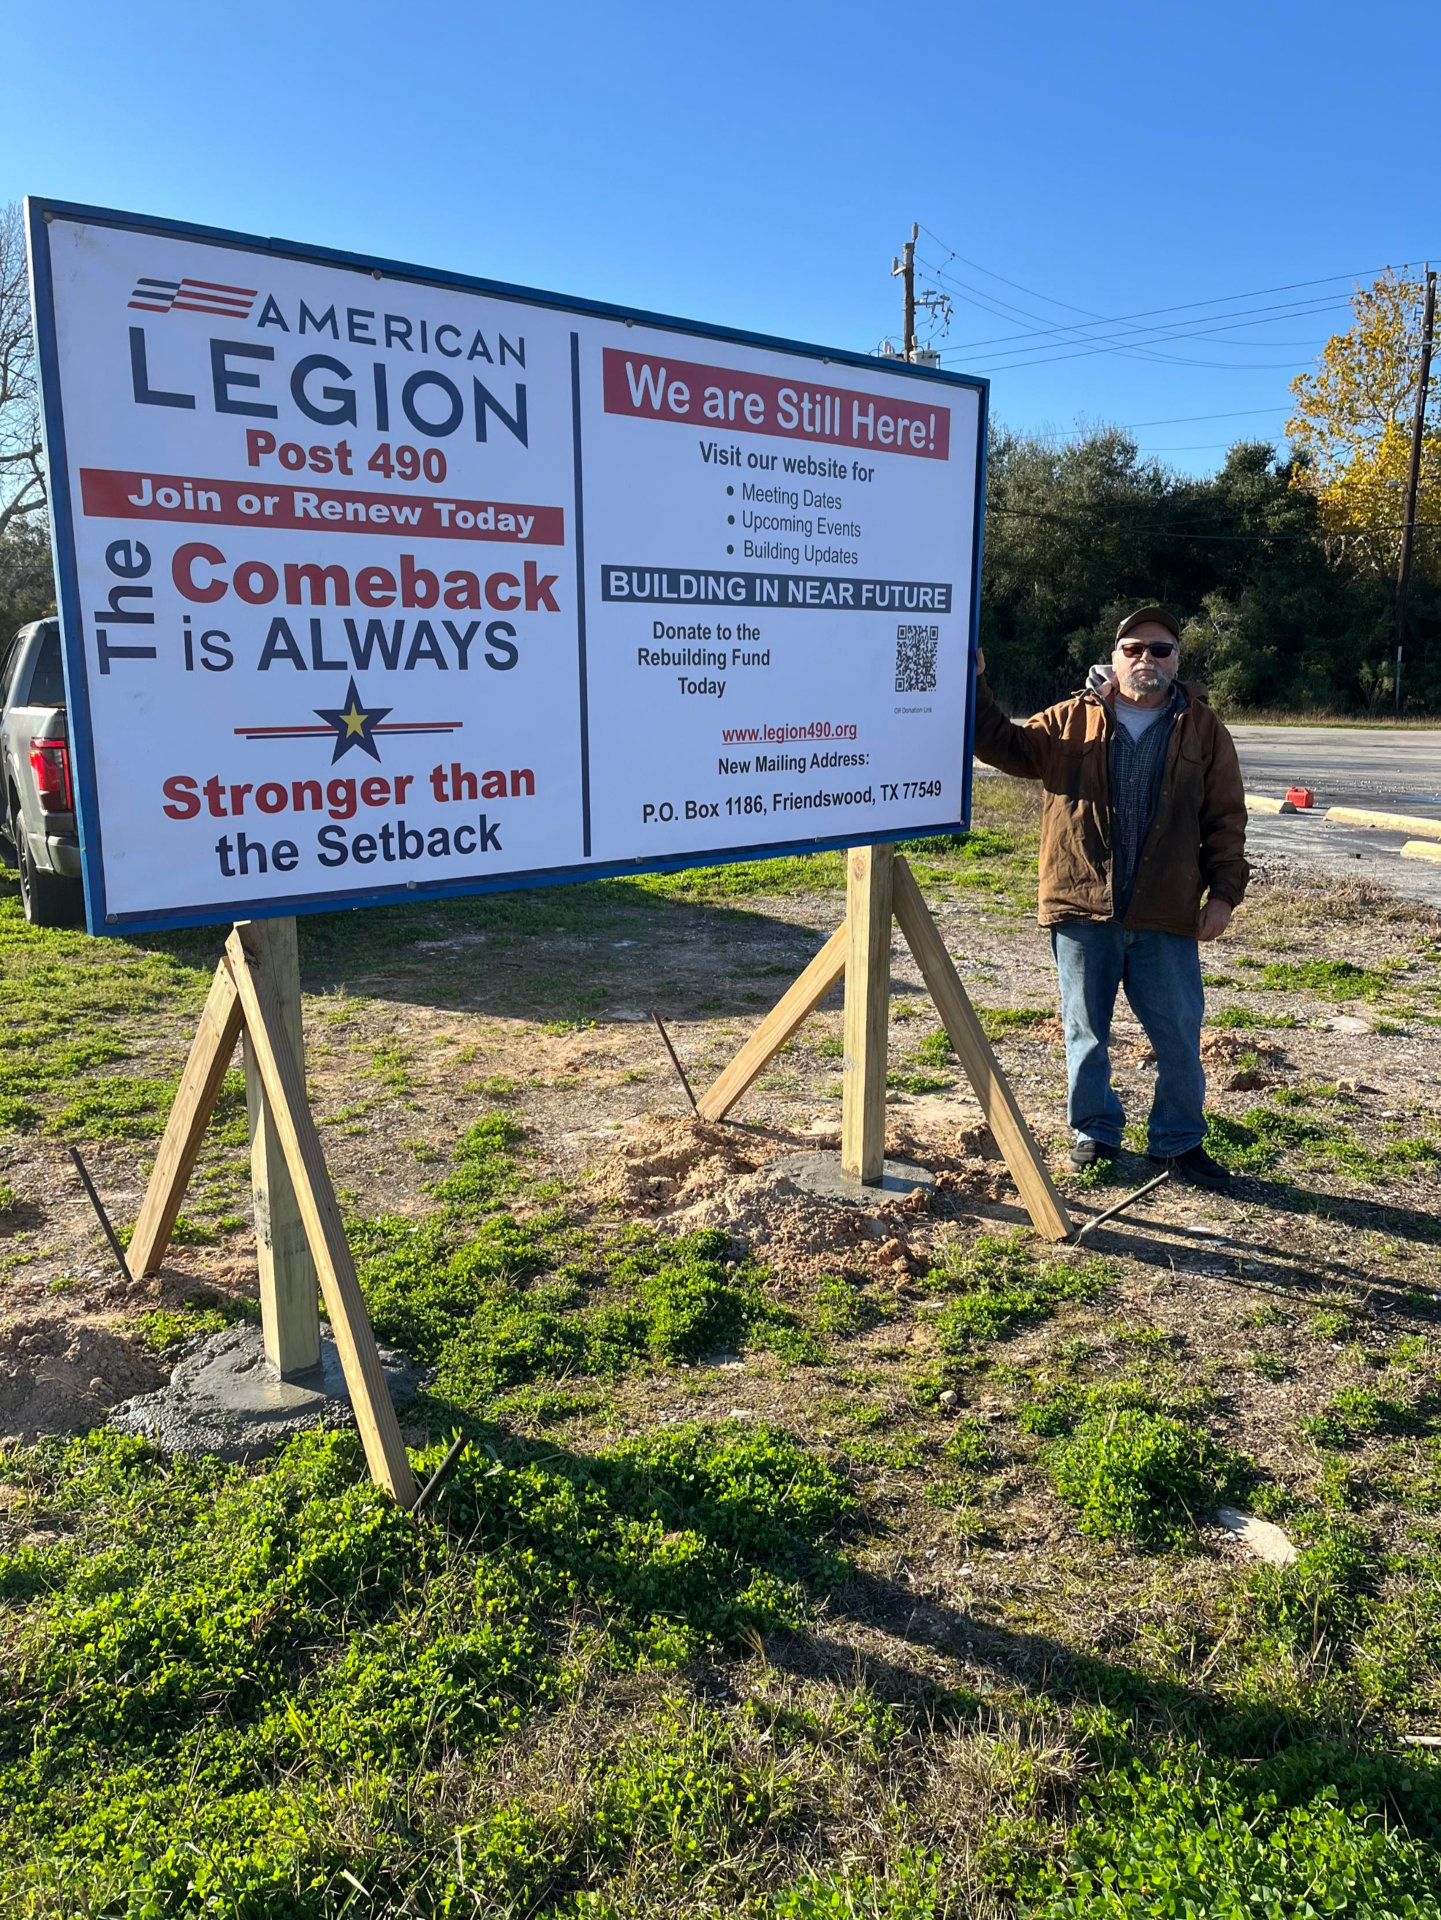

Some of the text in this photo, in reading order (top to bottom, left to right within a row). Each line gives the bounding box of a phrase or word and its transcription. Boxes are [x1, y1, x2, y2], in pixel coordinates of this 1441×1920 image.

[257, 293, 525, 368] AMERICAN
[129, 327, 528, 449] LEGION
[625, 361, 935, 450] We are Still Here!
[246, 429, 447, 483] Post 490
[700, 441, 875, 482] Visit our website for
[128, 479, 534, 537] Join or Renew Today
[742, 483, 842, 510] Meeting Dates
[742, 511, 861, 538] Upcoming Events
[744, 541, 858, 566] Building Updates
[172, 542, 561, 612] Comeback
[610, 571, 946, 608] BUILDING IN NEAR FUTURE
[95, 539, 157, 674] The
[183, 616, 519, 672] is ALWAYS
[653, 621, 760, 641] Donate to the
[638, 648, 770, 670] Rebuilding Fund
[678, 678, 726, 698] Today
[722, 721, 857, 744] www.legion490.org
[718, 751, 869, 775] New Mailing Address:
[162, 763, 535, 820] Stronger than
[643, 780, 942, 823] P.O. Box 1186, Friendswood, TX 77549
[215, 815, 503, 877] the Setback
